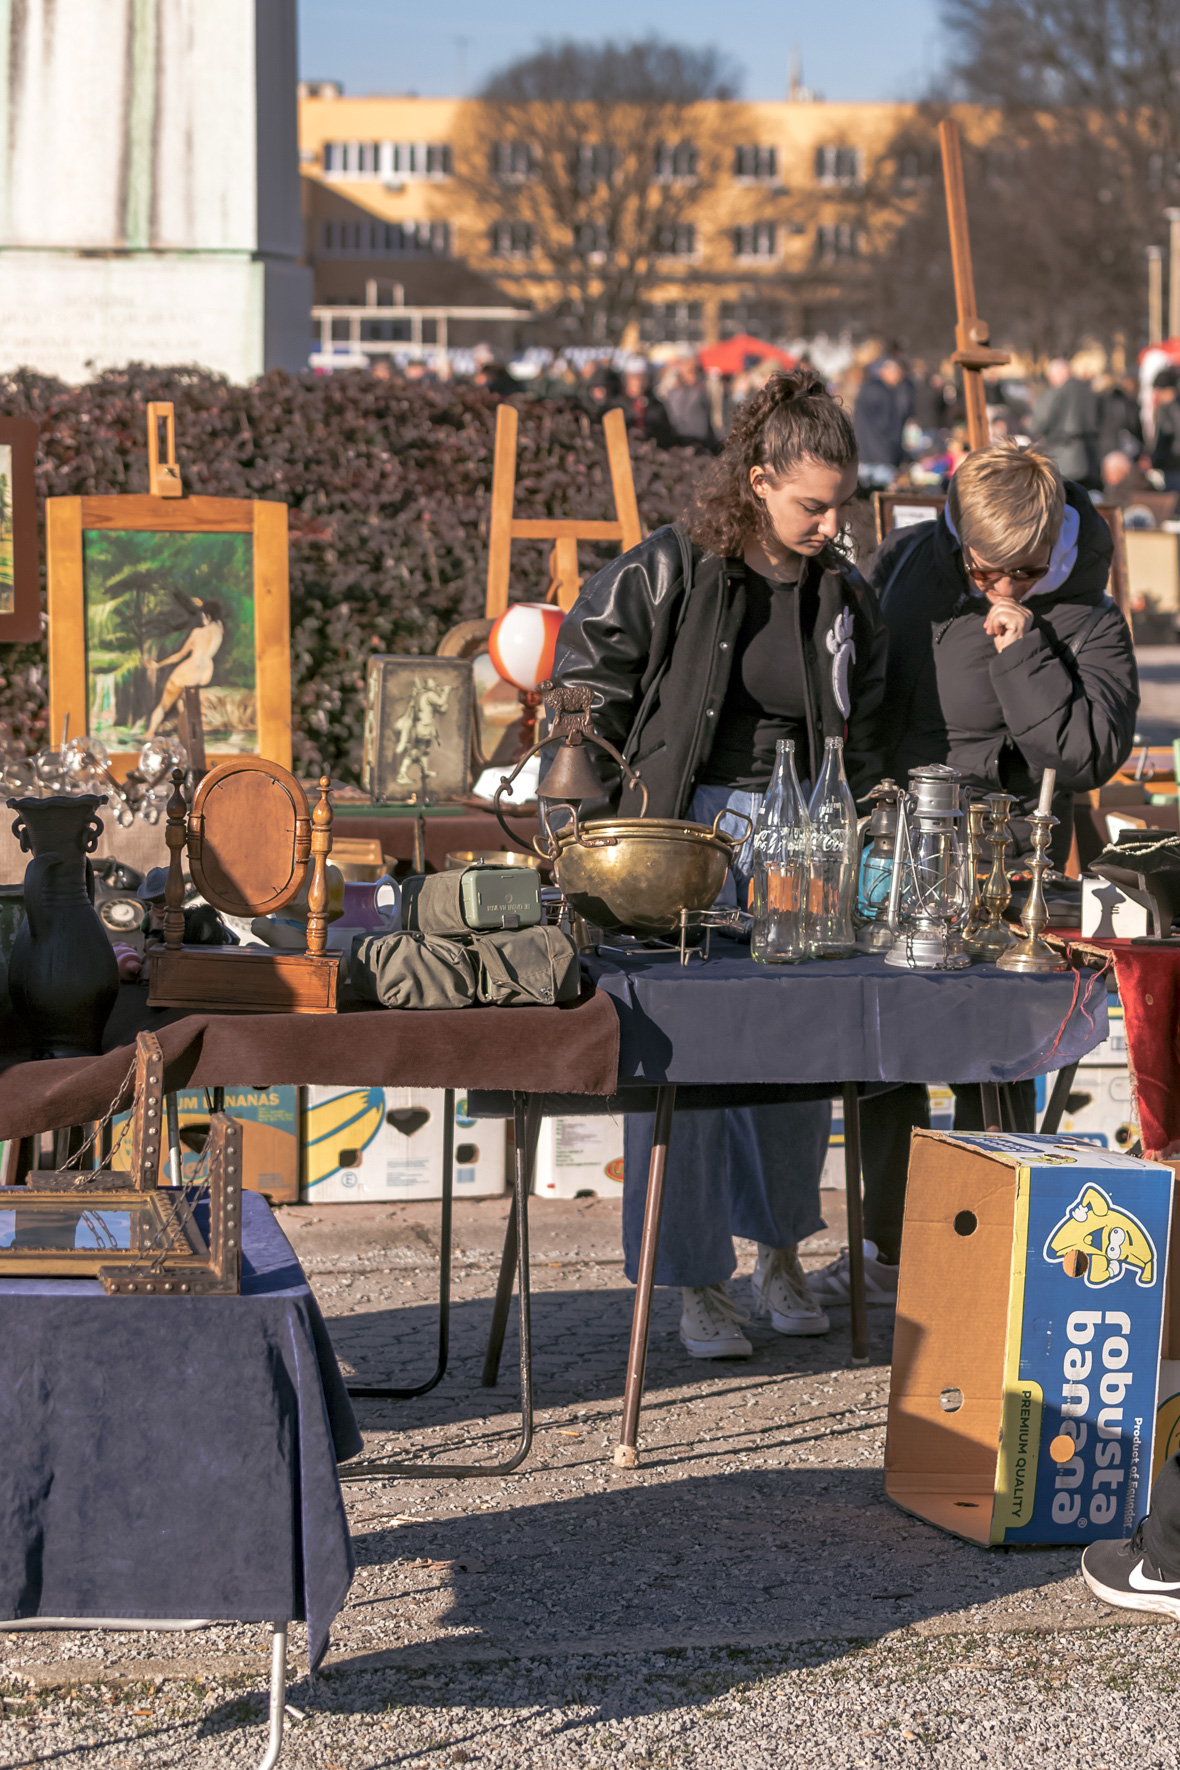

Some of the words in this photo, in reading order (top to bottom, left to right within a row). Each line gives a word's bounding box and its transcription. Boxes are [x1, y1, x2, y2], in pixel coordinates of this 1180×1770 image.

[203, 1093, 280, 1109] BNANAS
[1017, 1390, 1032, 1454] PREMIUM
[1089, 1311, 1133, 1525] robusta
[1131, 1417, 1143, 1464] Product
[1011, 1457, 1027, 1518] QUALITY
[1131, 1466, 1140, 1479] of
